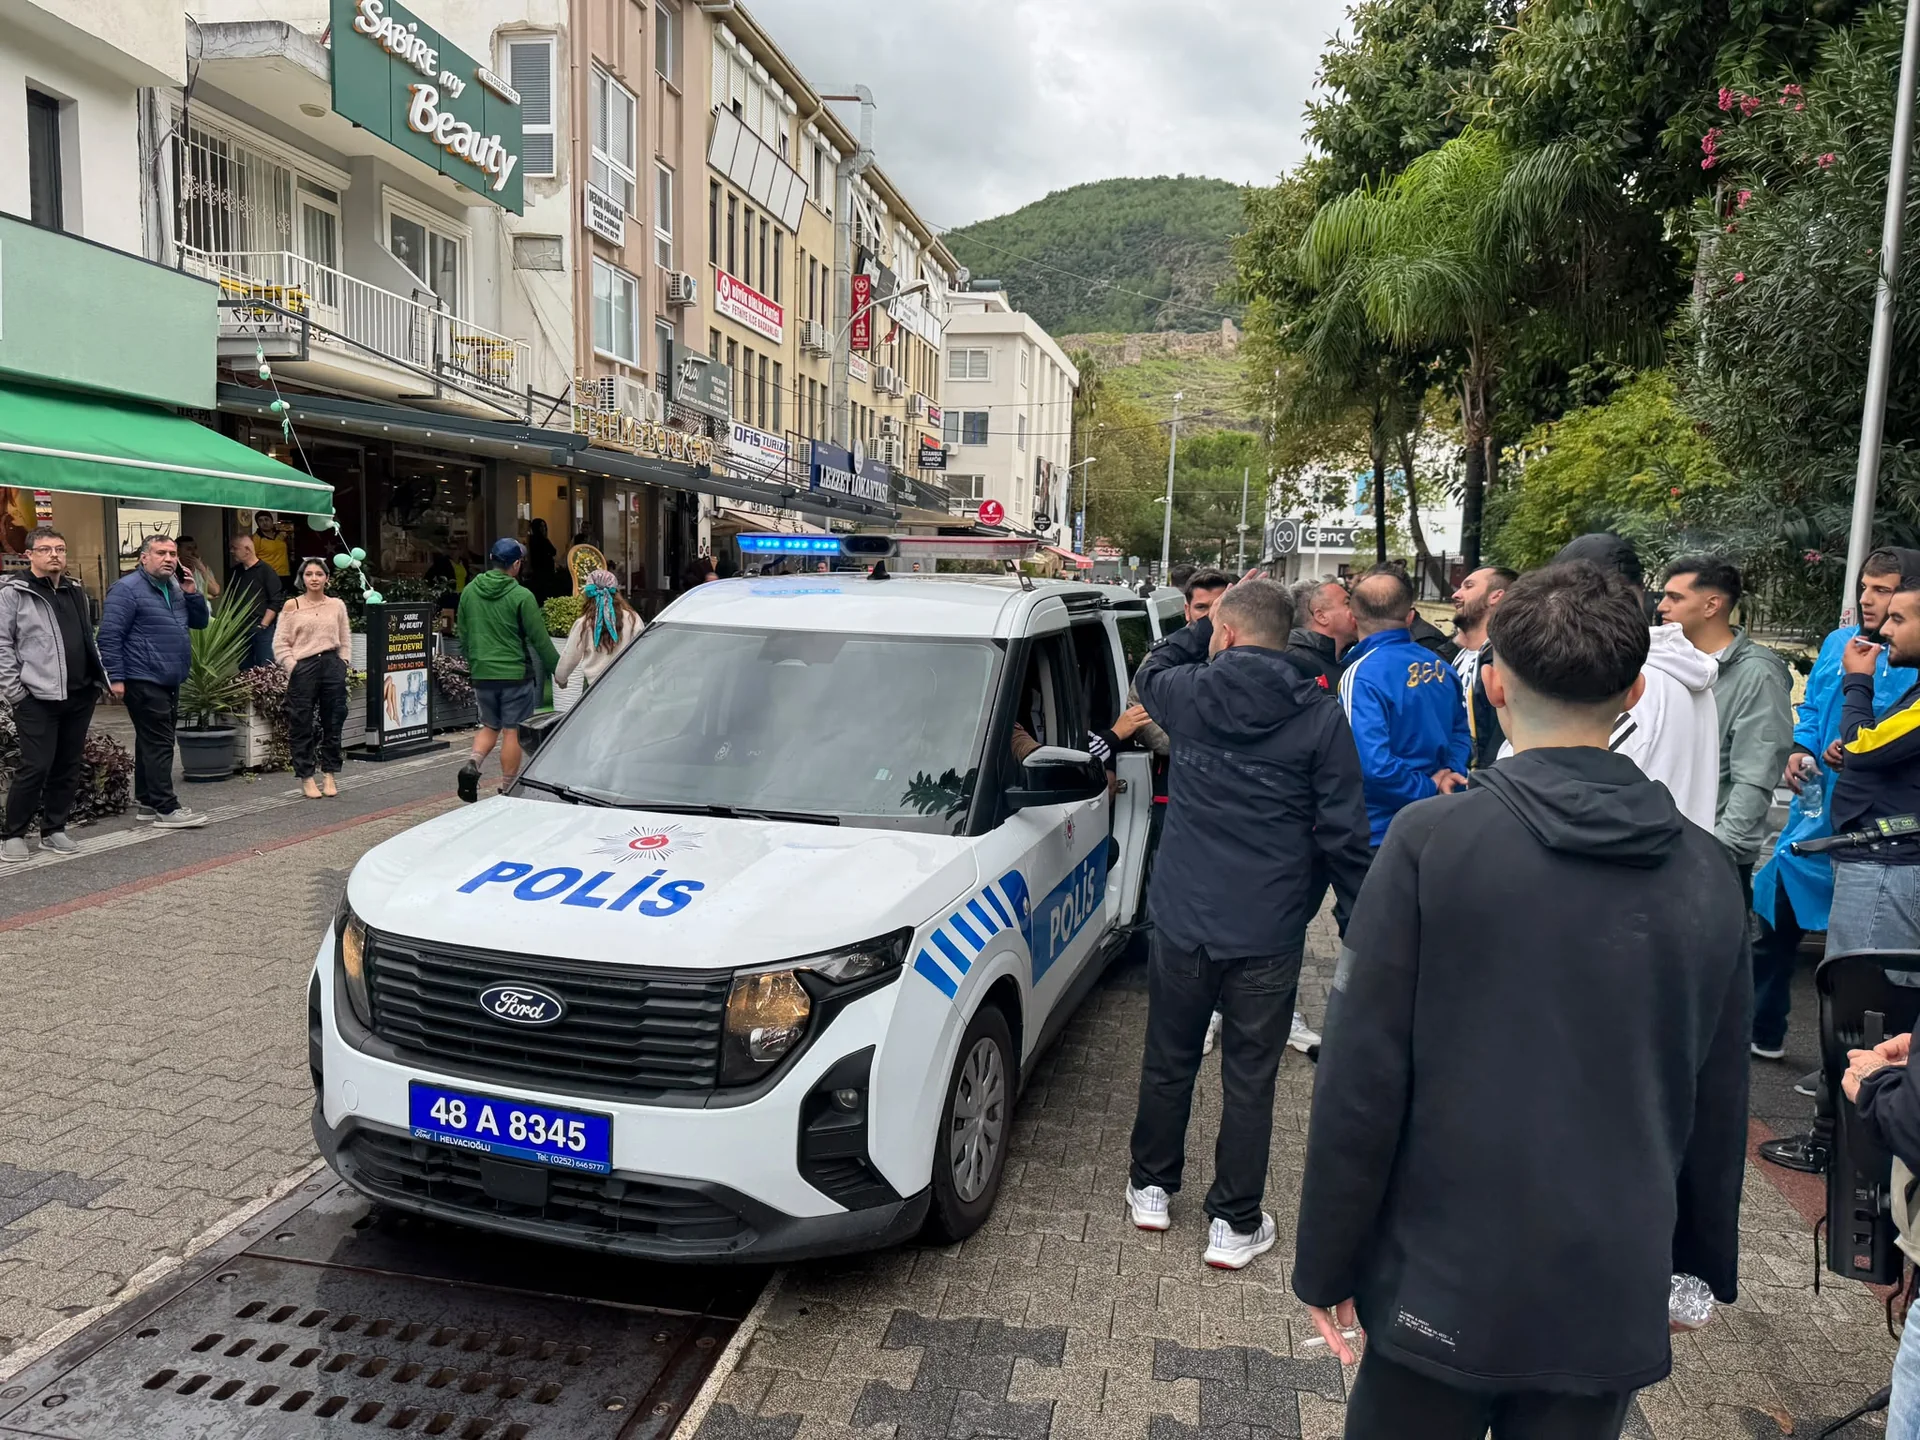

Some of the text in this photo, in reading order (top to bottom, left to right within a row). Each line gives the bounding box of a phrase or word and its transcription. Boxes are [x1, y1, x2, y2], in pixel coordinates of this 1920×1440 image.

[439, 71, 466, 99] my
[409, 84, 517, 191] Beauty
[732, 284, 748, 307] BÜYÜK
[732, 303, 748, 321] FETHİYE
[820, 464, 851, 494] LEZZET
[851, 474, 889, 504] LOKANTASI
[1305, 528, 1346, 546] Genç
[388, 632, 424, 643] Epilasyonda
[388, 640, 423, 652] BUZ DEVRİ
[456, 860, 705, 917] POLİS
[1049, 859, 1095, 959] POLİS
[495, 990, 546, 1020] Ford
[430, 1096, 587, 1152] 48 A 8345
[414, 1128, 491, 1152] Ford HELVACIOĞLU
[550, 1155, 575, 1168] (0252)
